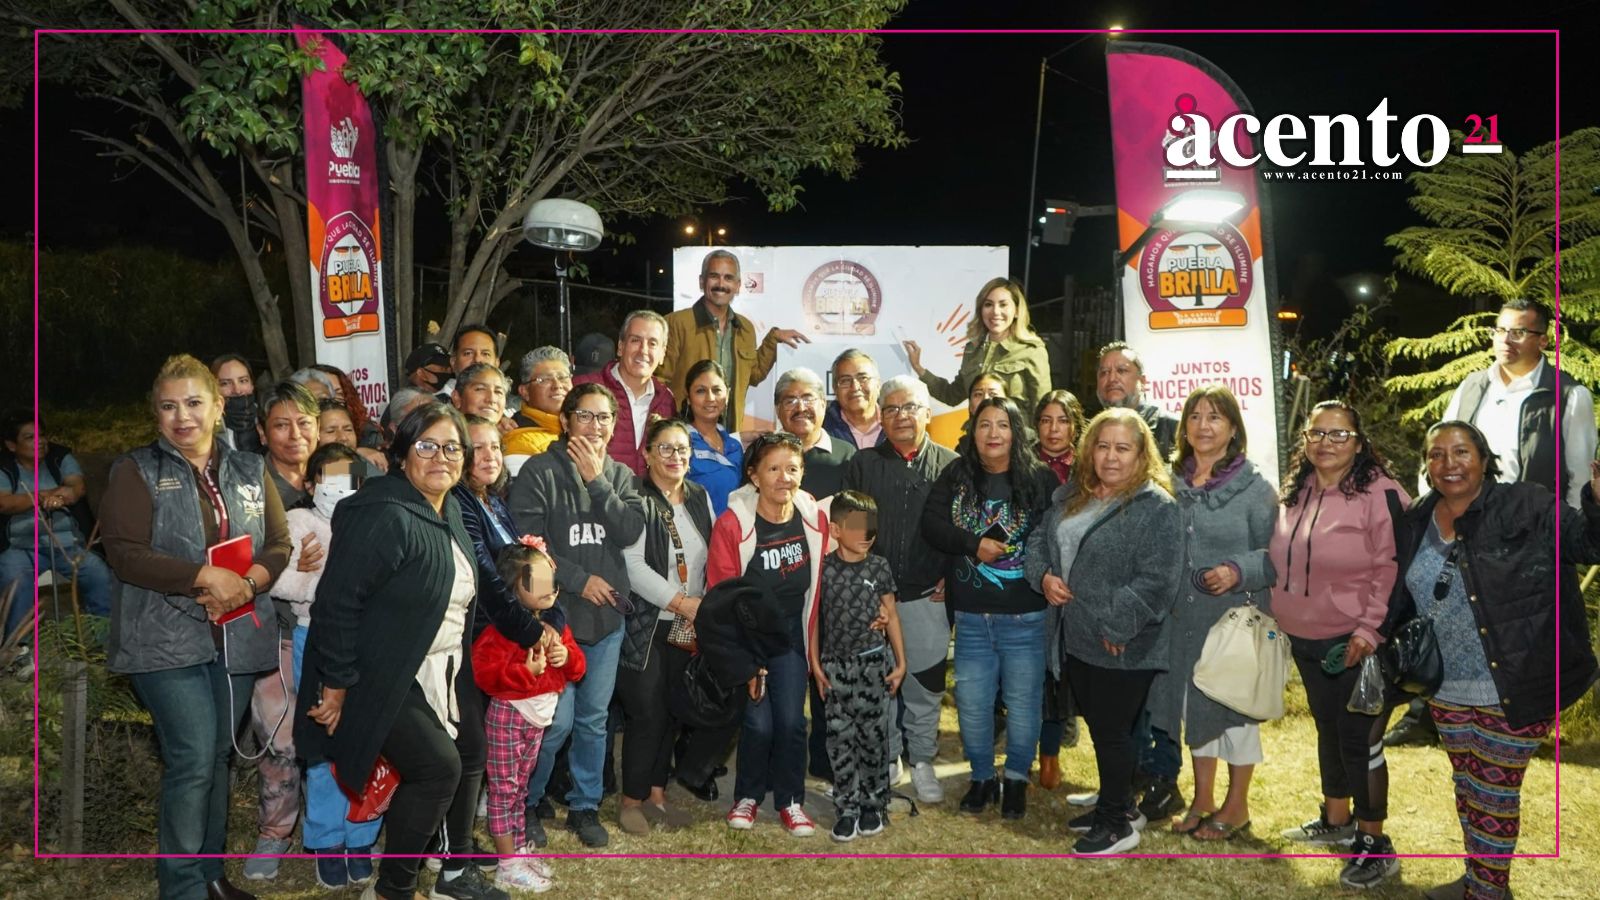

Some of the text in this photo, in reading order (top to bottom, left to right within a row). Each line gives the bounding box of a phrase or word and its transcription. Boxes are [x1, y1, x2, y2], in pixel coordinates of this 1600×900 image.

[328, 160, 360, 178] Puebla
[1146, 242, 1163, 288] HAGAMOS
[1233, 244, 1248, 284] ILUMINE
[1167, 256, 1225, 272] PUEBLA
[1159, 269, 1239, 298] BRILLA
[1172, 361, 1230, 375] JUNTOS
[569, 522, 606, 547] GAP
[761, 548, 781, 570] 10
[780, 543, 803, 559] AÑOS
